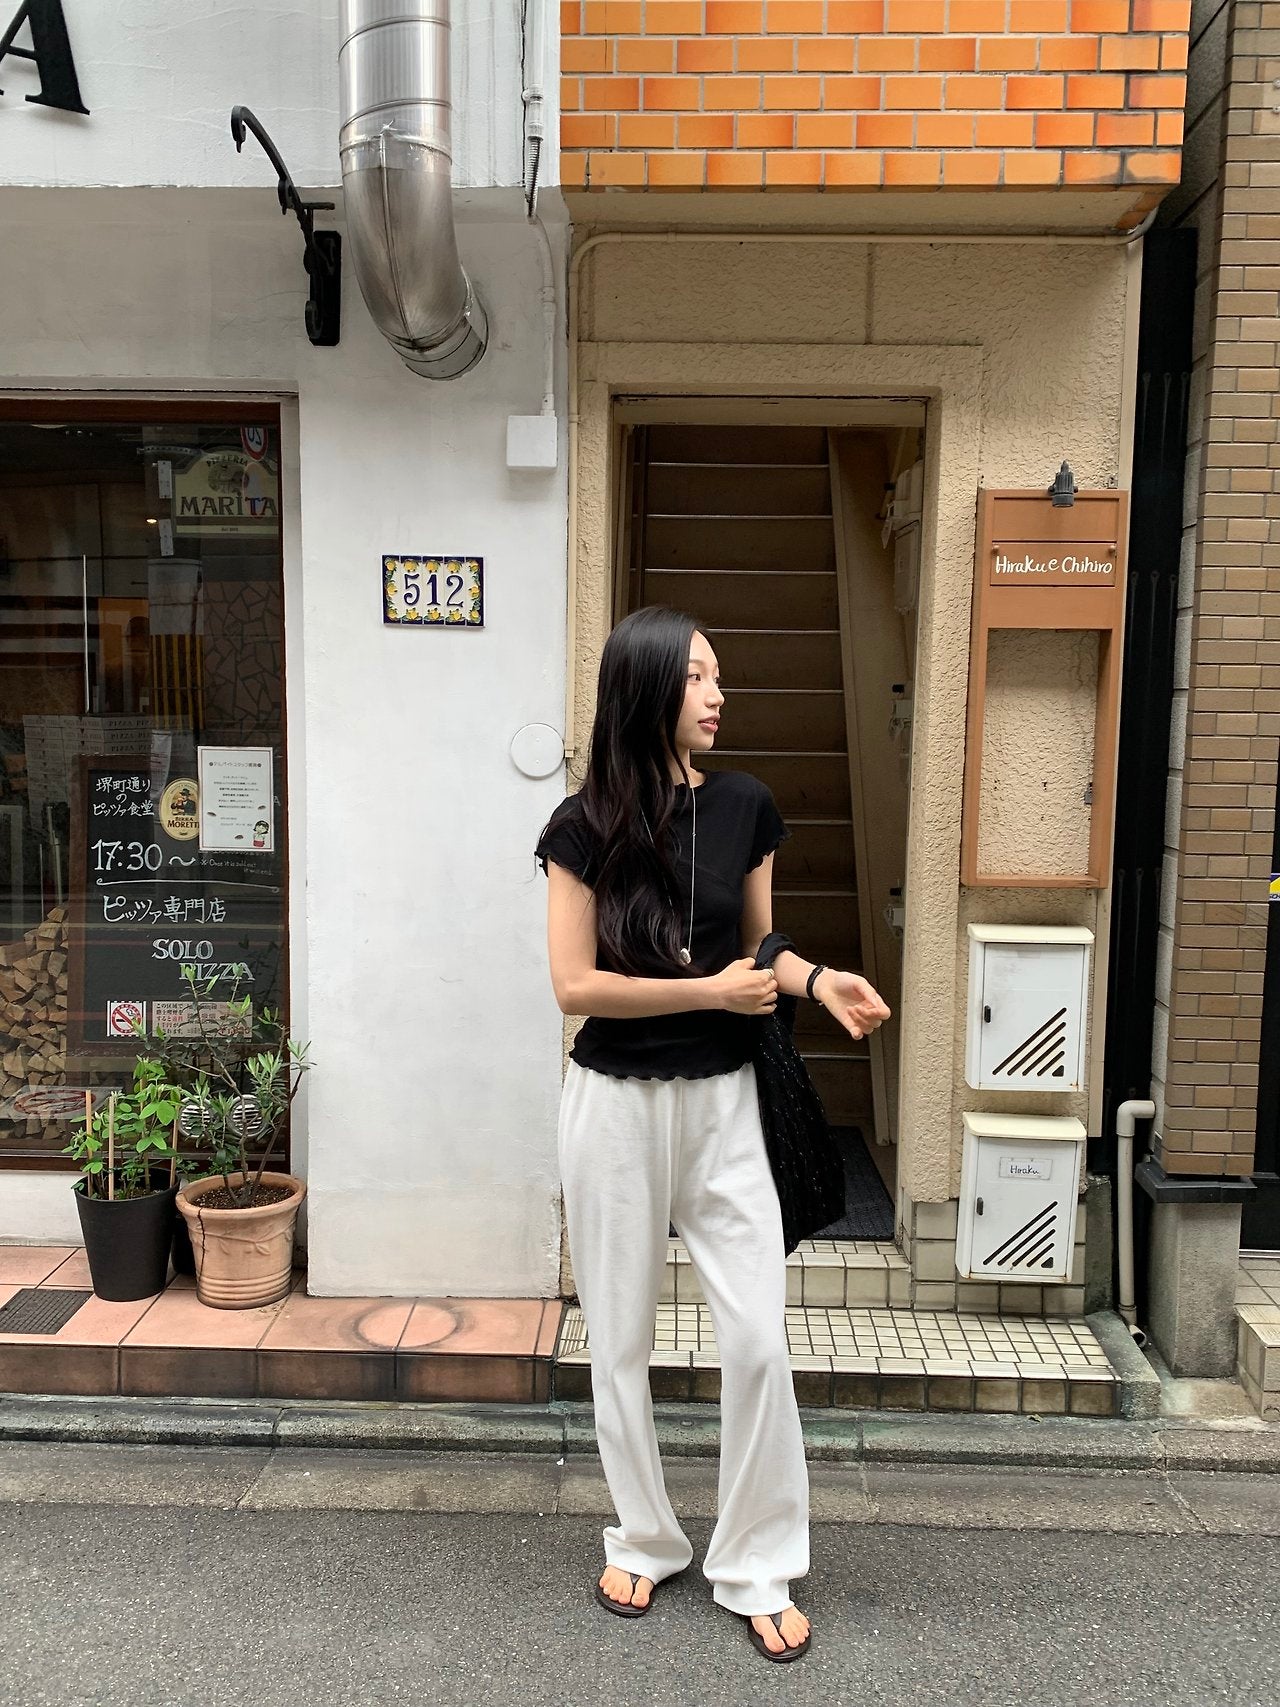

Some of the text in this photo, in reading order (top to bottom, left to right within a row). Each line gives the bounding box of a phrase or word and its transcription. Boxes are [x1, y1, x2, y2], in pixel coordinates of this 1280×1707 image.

[995, 555, 1113, 573] Hiraku e Chihiro
[403, 573, 464, 607] 512
[96, 776, 151, 793] 堺町通り
[115, 793, 127, 803] の
[93, 799, 154, 816] ピッツァ食堂
[103, 895, 227, 924] ピッツァ専門店
[151, 938, 214, 960] SOLO
[1010, 1164, 1040, 1175] Hiraku
